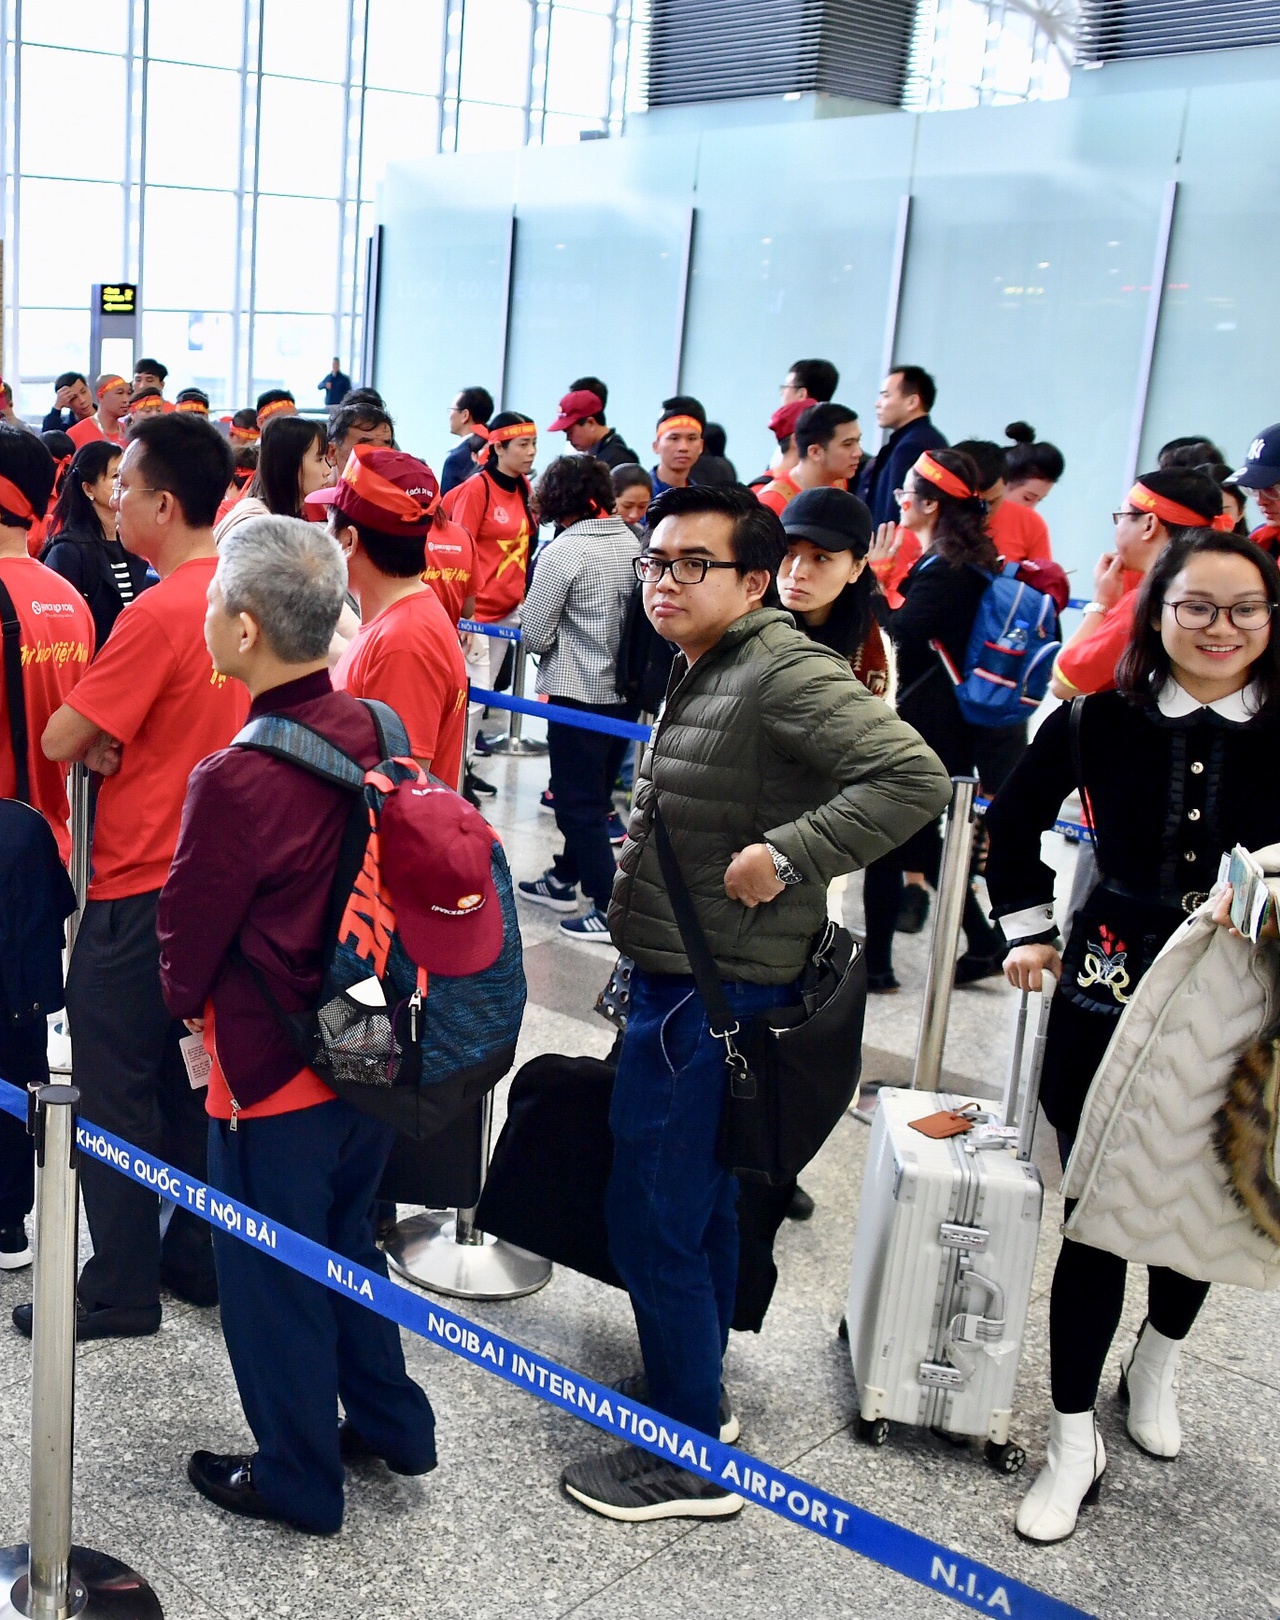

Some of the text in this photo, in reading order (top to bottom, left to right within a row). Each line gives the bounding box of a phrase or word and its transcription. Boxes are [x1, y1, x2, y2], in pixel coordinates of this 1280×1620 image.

[76, 1127, 1012, 1616] KHÔNG QUỐC TẾ NỘI BÀI N.I.A NOIBAI INTERNATIONAL AIRPORT N.I.A
